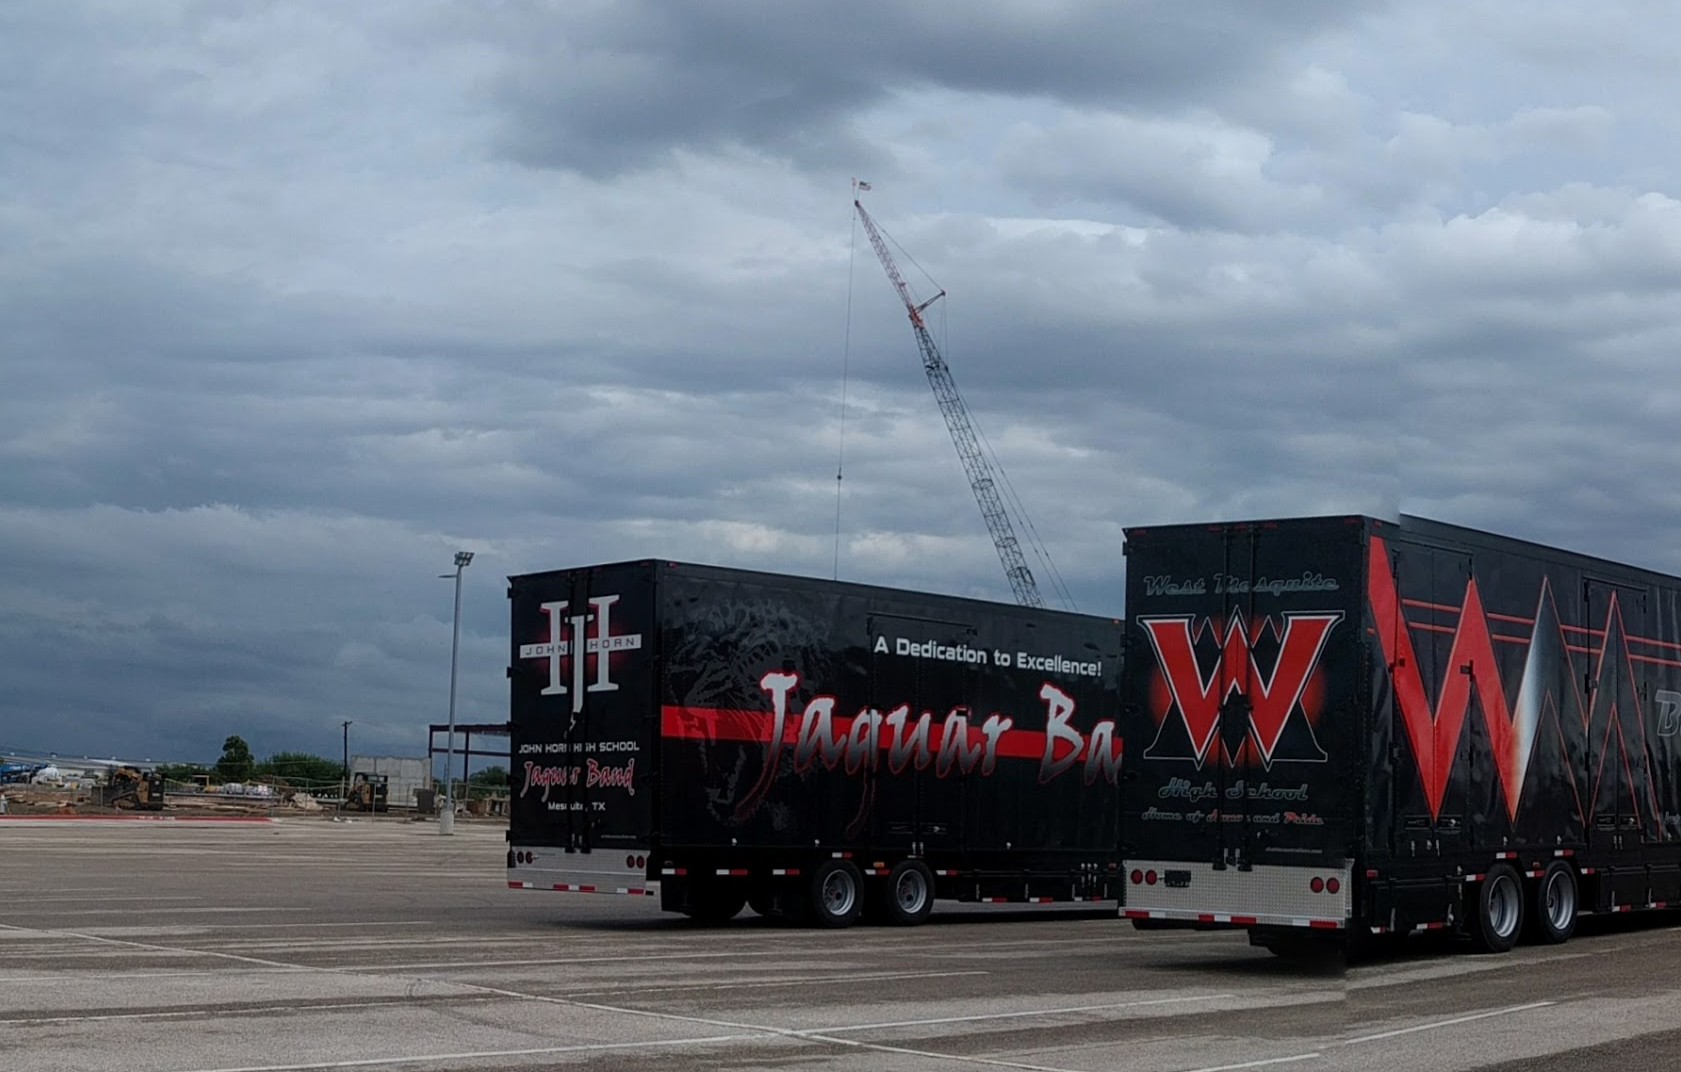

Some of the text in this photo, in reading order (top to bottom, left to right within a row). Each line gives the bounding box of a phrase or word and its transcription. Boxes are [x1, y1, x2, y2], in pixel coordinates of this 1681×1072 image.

[1144, 570, 1340, 597] West Mesquite
[525, 636, 635, 656] JOHN HORN
[873, 636, 1103, 677] A Dedication to Excellence!
[518, 743, 543, 755] JOHN
[599, 740, 641, 752] SCHOOL
[733, 671, 1012, 842] Jaguar
[586, 757, 636, 797] Band
[1158, 777, 1309, 803] High School
[592, 801, 607, 812] TX
[1252, 811, 1281, 824] and
[1283, 811, 1324, 826] Pride
